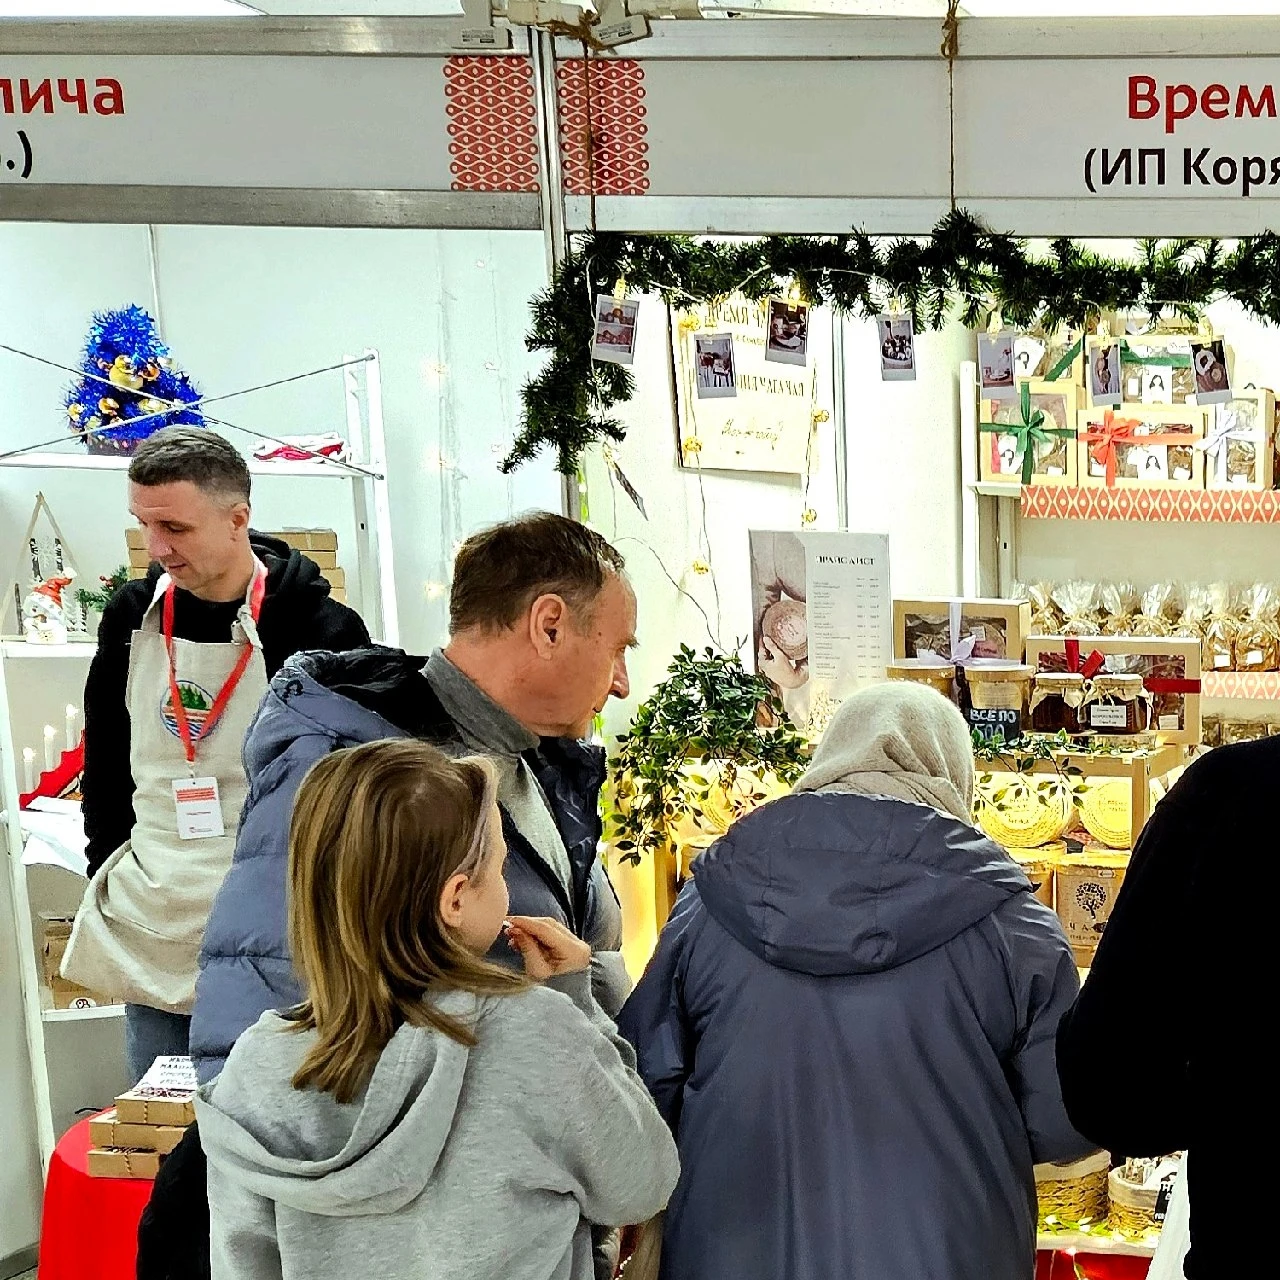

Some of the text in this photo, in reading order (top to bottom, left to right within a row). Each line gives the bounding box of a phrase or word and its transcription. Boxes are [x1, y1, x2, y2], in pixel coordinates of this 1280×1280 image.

[1083, 146, 1166, 193] (ИП
[970, 708, 1017, 724] ВСЕ ПО
